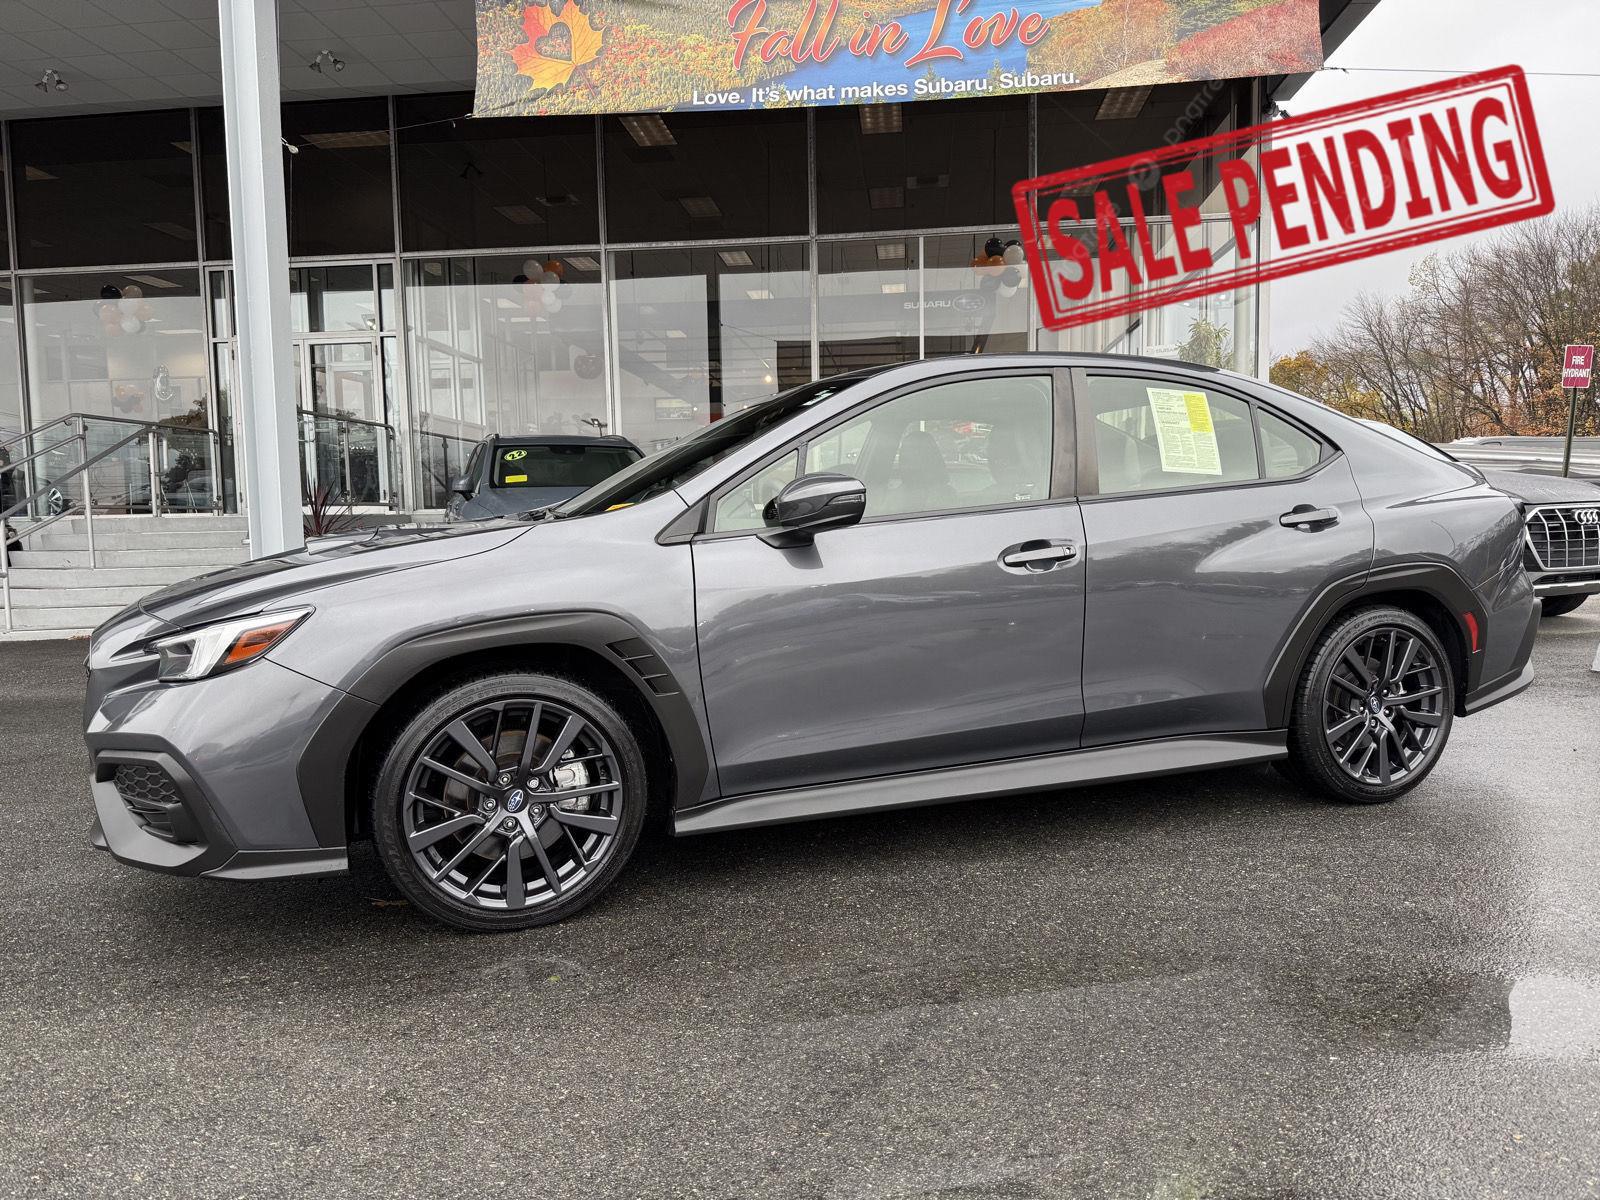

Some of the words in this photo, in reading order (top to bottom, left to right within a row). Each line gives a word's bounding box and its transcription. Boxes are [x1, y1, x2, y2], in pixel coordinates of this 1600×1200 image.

[726, 0, 840, 71] Fall
[849, 11, 909, 57] in
[904, 0, 1051, 68] Love
[692, 90, 744, 106] Love.
[751, 87, 780, 103] It's
[786, 84, 835, 101] what
[841, 81, 908, 99] makes
[913, 77, 993, 96] Subaru,
[999, 71, 1081, 90] Subaru.
[1571, 355, 1585, 365] FIRE
[1563, 368, 1590, 378] HYDRANT
